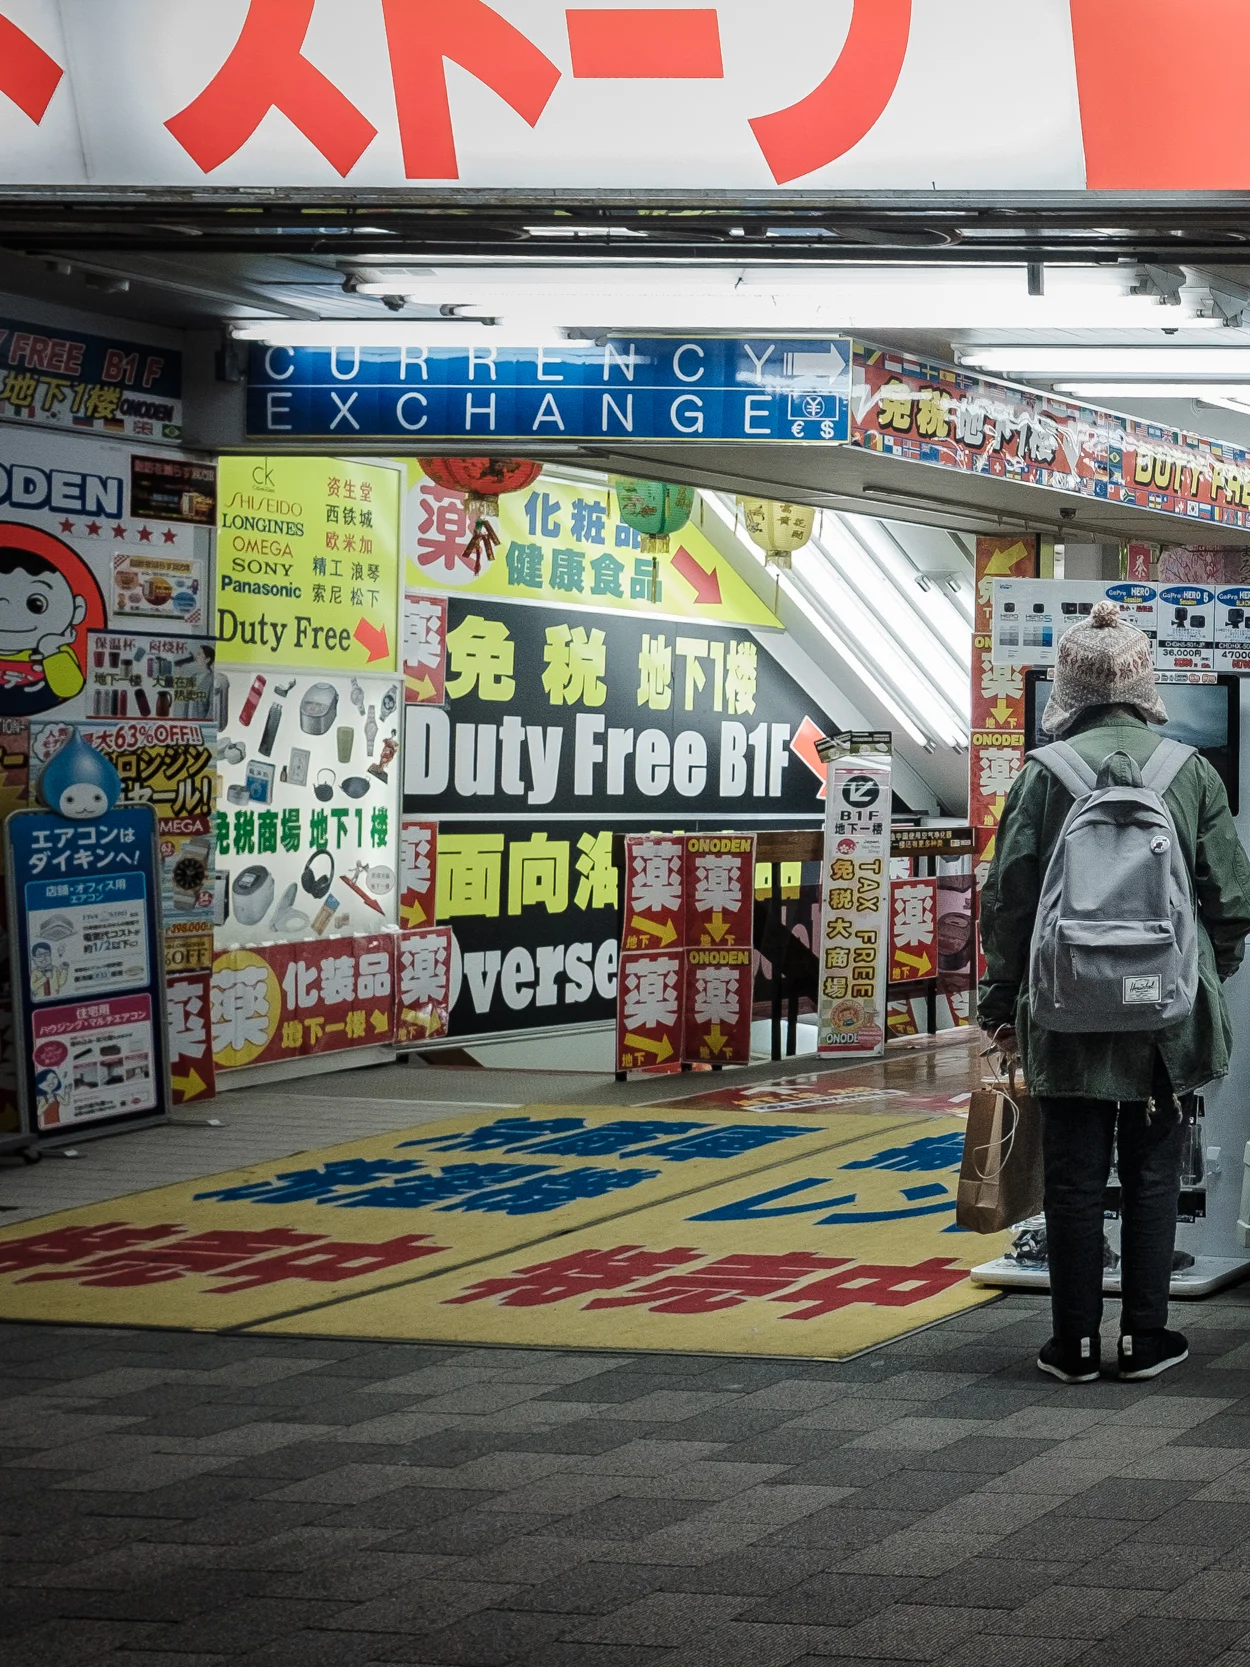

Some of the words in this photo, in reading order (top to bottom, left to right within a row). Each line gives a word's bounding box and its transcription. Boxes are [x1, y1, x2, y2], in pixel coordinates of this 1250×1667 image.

[9, 332, 86, 377] FREE
[265, 344, 775, 383] CURRENCY
[266, 391, 773, 433] EXCHANGE
[1135, 450, 1201, 496] DUTY
[224, 492, 302, 517] SHISEIDO
[327, 476, 372, 502] 资生堂
[222, 513, 304, 537] LONGINES
[325, 504, 373, 529] 西铁城
[232, 536, 293, 558] OMEGA
[325, 531, 373, 555] 欧米加
[232, 558, 293, 577] SONY
[313, 555, 343, 578] 精工
[351, 561, 379, 583] 浪琴
[505, 541, 663, 603] 健康食品
[221, 574, 302, 599] Panasonic
[312, 583, 342, 604] 索尼
[350, 587, 379, 608] 松下
[1108, 589, 1126, 597] GoPro
[1131, 587, 1149, 596] HERO
[1184, 591, 1201, 600] HERO
[217, 608, 287, 653] Duty
[294, 615, 351, 652] Free
[444, 614, 607, 706] 免税
[637, 633, 758, 716] 地下1楼
[103, 747, 212, 782] ロンジン
[403, 706, 564, 805] Duty
[574, 713, 708, 798] Free
[719, 721, 791, 798] B1F
[158, 819, 204, 834] MEGA
[834, 823, 883, 836] 地下一楼
[840, 810, 879, 821] B1F
[31, 826, 136, 849] エアコンは
[688, 838, 751, 853] ONODEN
[28, 849, 140, 874] ダイキンへ!
[631, 841, 683, 912] 薬
[695, 854, 742, 912] 薬
[854, 858, 883, 913] TAX
[822, 858, 856, 1000] 免税大商場
[894, 884, 935, 947] 薬
[401, 934, 448, 1005] 薬
[689, 951, 749, 965] ONODEN
[850, 929, 877, 999] FREE
[624, 957, 679, 1031] 薬
[694, 966, 740, 1025] 薬
